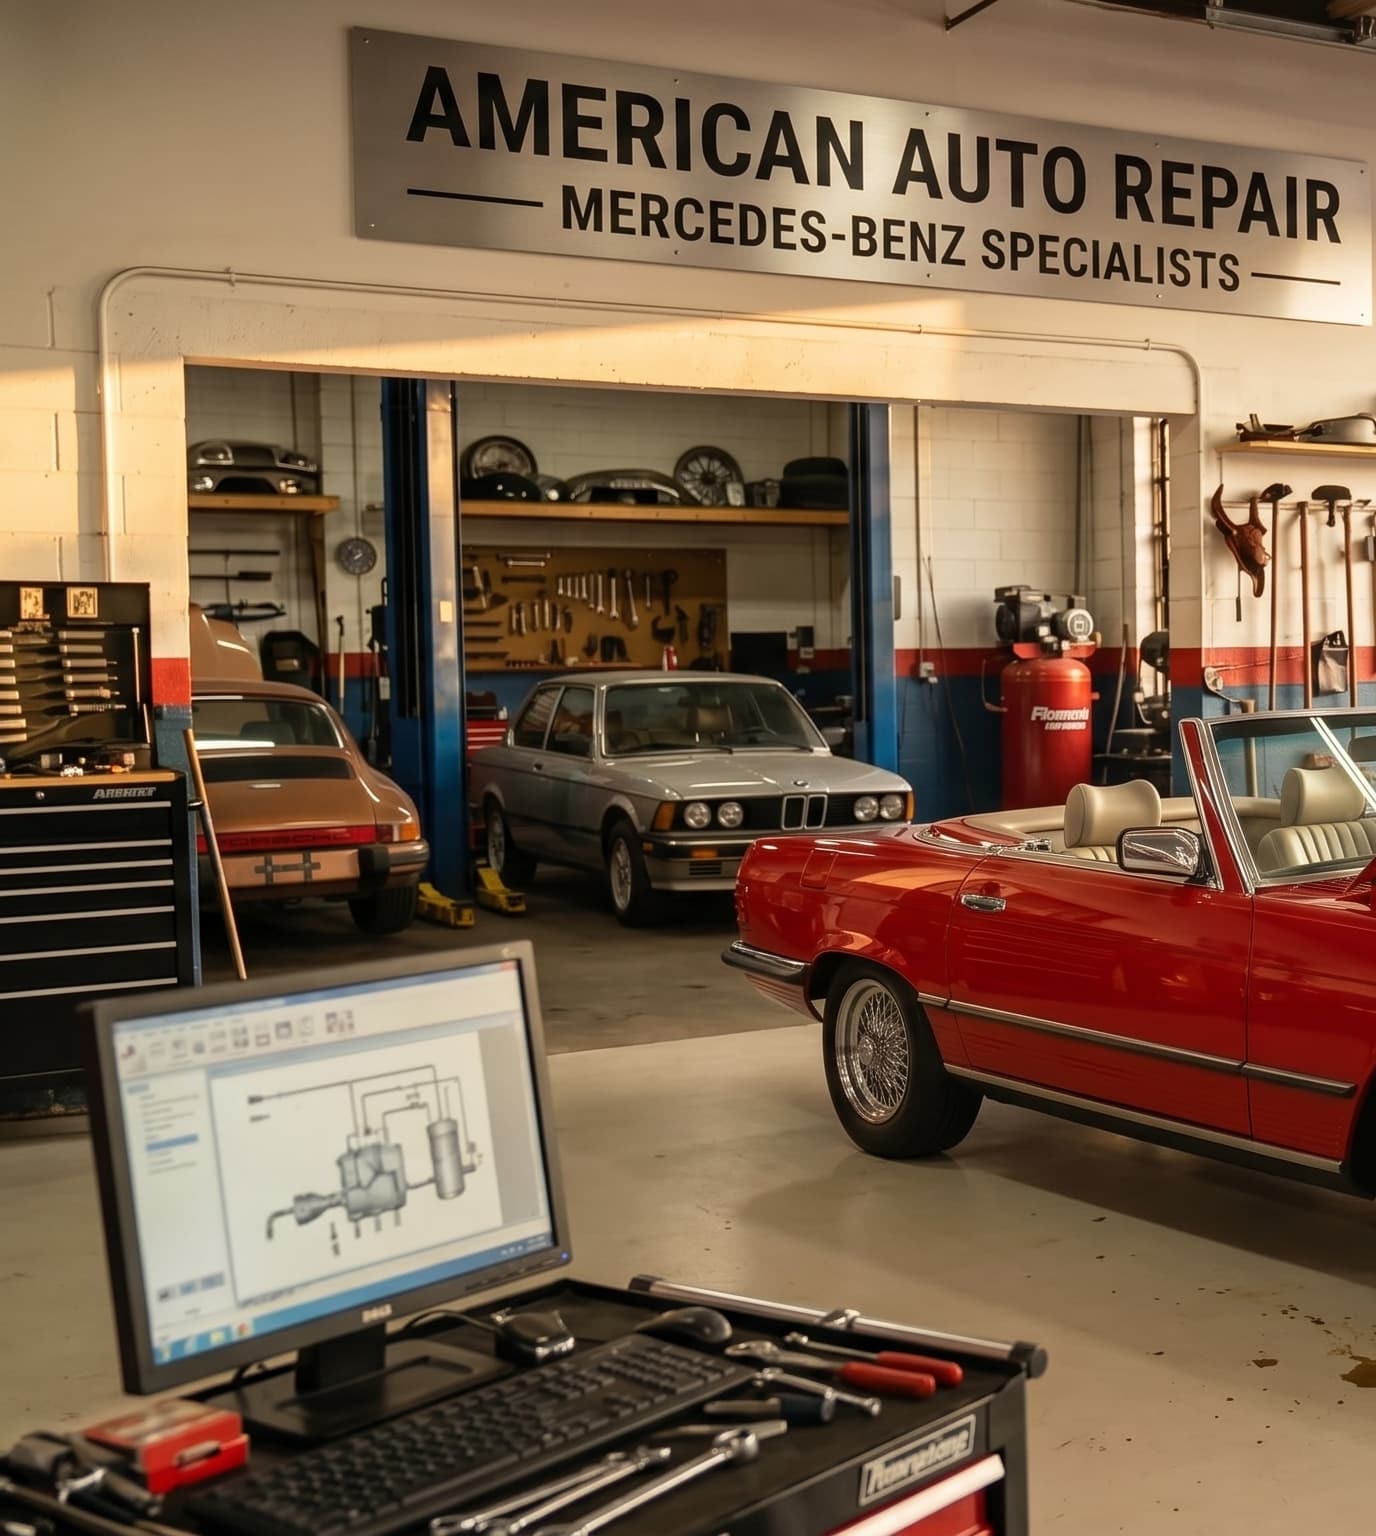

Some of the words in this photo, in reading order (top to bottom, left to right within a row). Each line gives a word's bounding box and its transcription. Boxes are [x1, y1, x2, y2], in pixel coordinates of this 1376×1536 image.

[405, 65, 864, 190] AMERICAN
[892, 127, 1086, 214] AUTO
[1114, 153, 1342, 244] REPAIR
[561, 184, 966, 266] MERCEDES-BENZ
[981, 228, 1239, 292] SPECIALISTS
